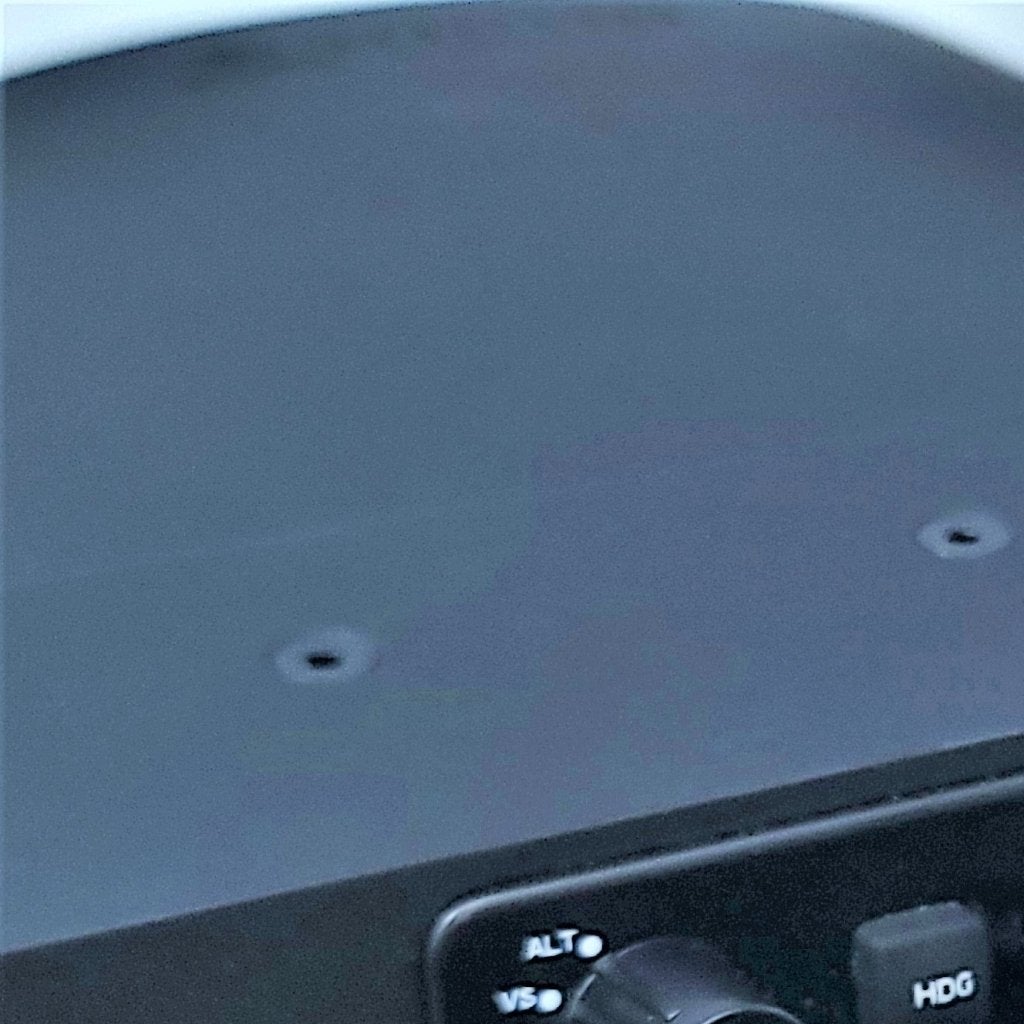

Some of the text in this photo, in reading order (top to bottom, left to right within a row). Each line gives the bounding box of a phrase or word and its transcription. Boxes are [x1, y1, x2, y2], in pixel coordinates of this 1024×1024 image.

[522, 929, 578, 961] ALT
[495, 985, 536, 1014] VS
[913, 971, 975, 1009] HDG
